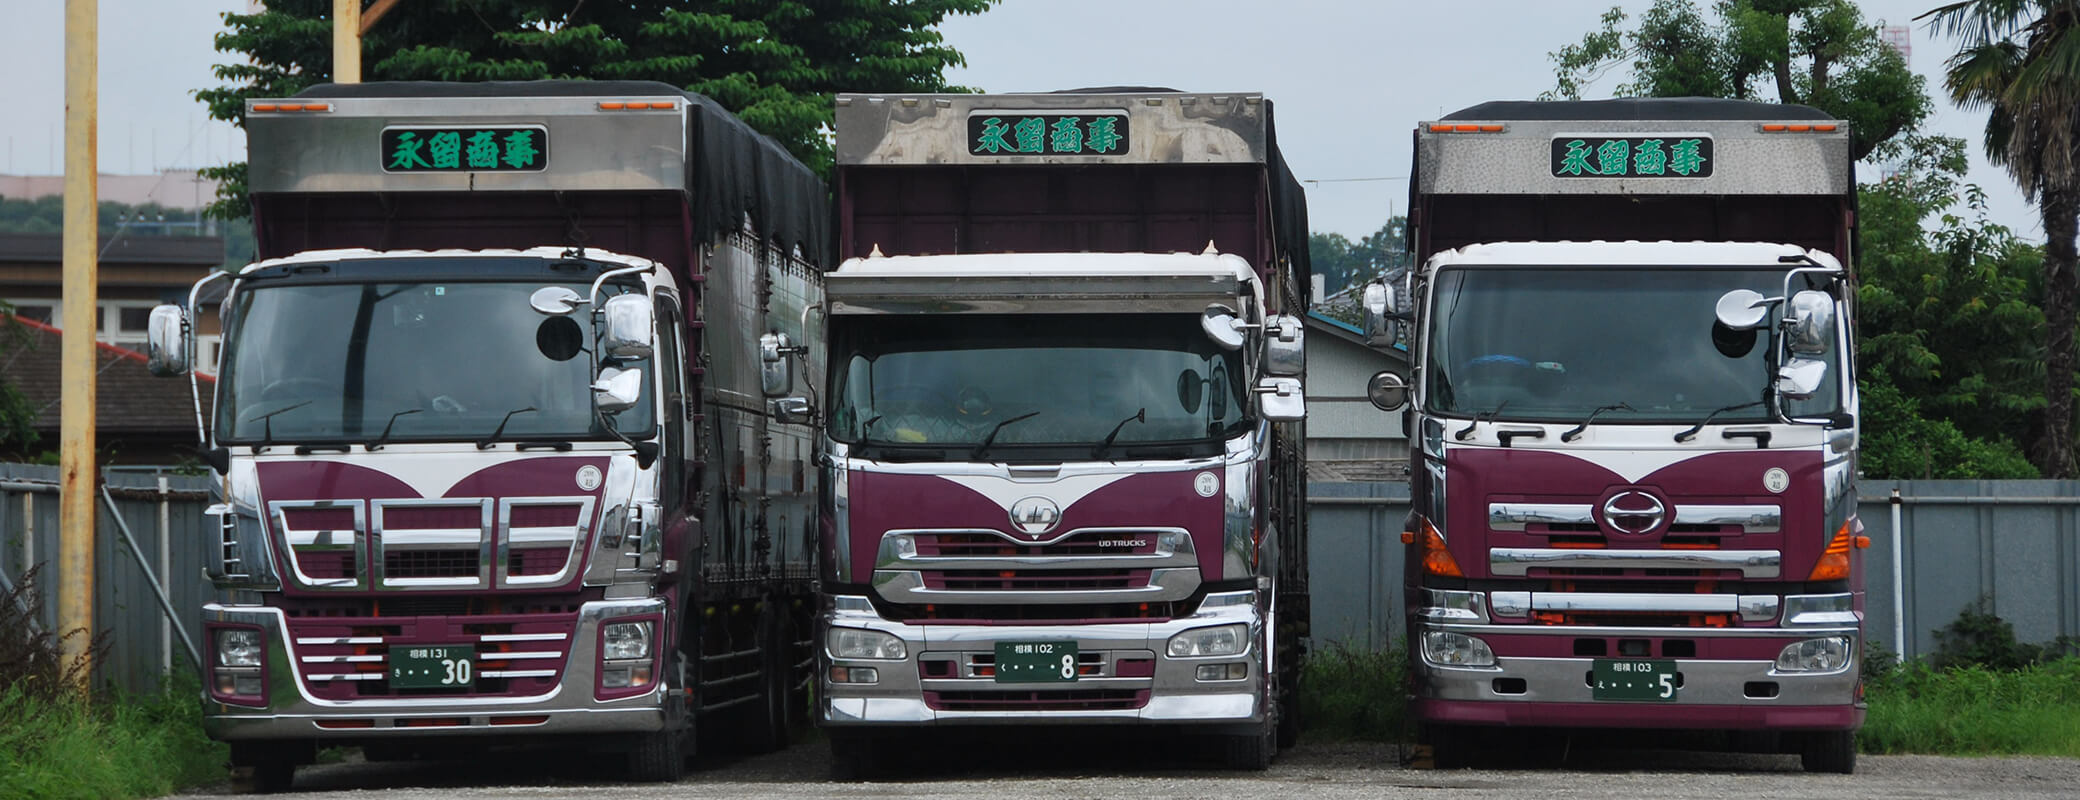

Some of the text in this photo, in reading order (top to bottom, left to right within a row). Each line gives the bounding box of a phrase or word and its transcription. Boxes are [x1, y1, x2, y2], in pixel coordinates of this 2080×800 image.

[387, 129, 540, 169] 永留商事
[974, 116, 1124, 153] 永留商事
[1556, 138, 1707, 176] 永留商事
[1112, 539, 1146, 547] TRUCKS
